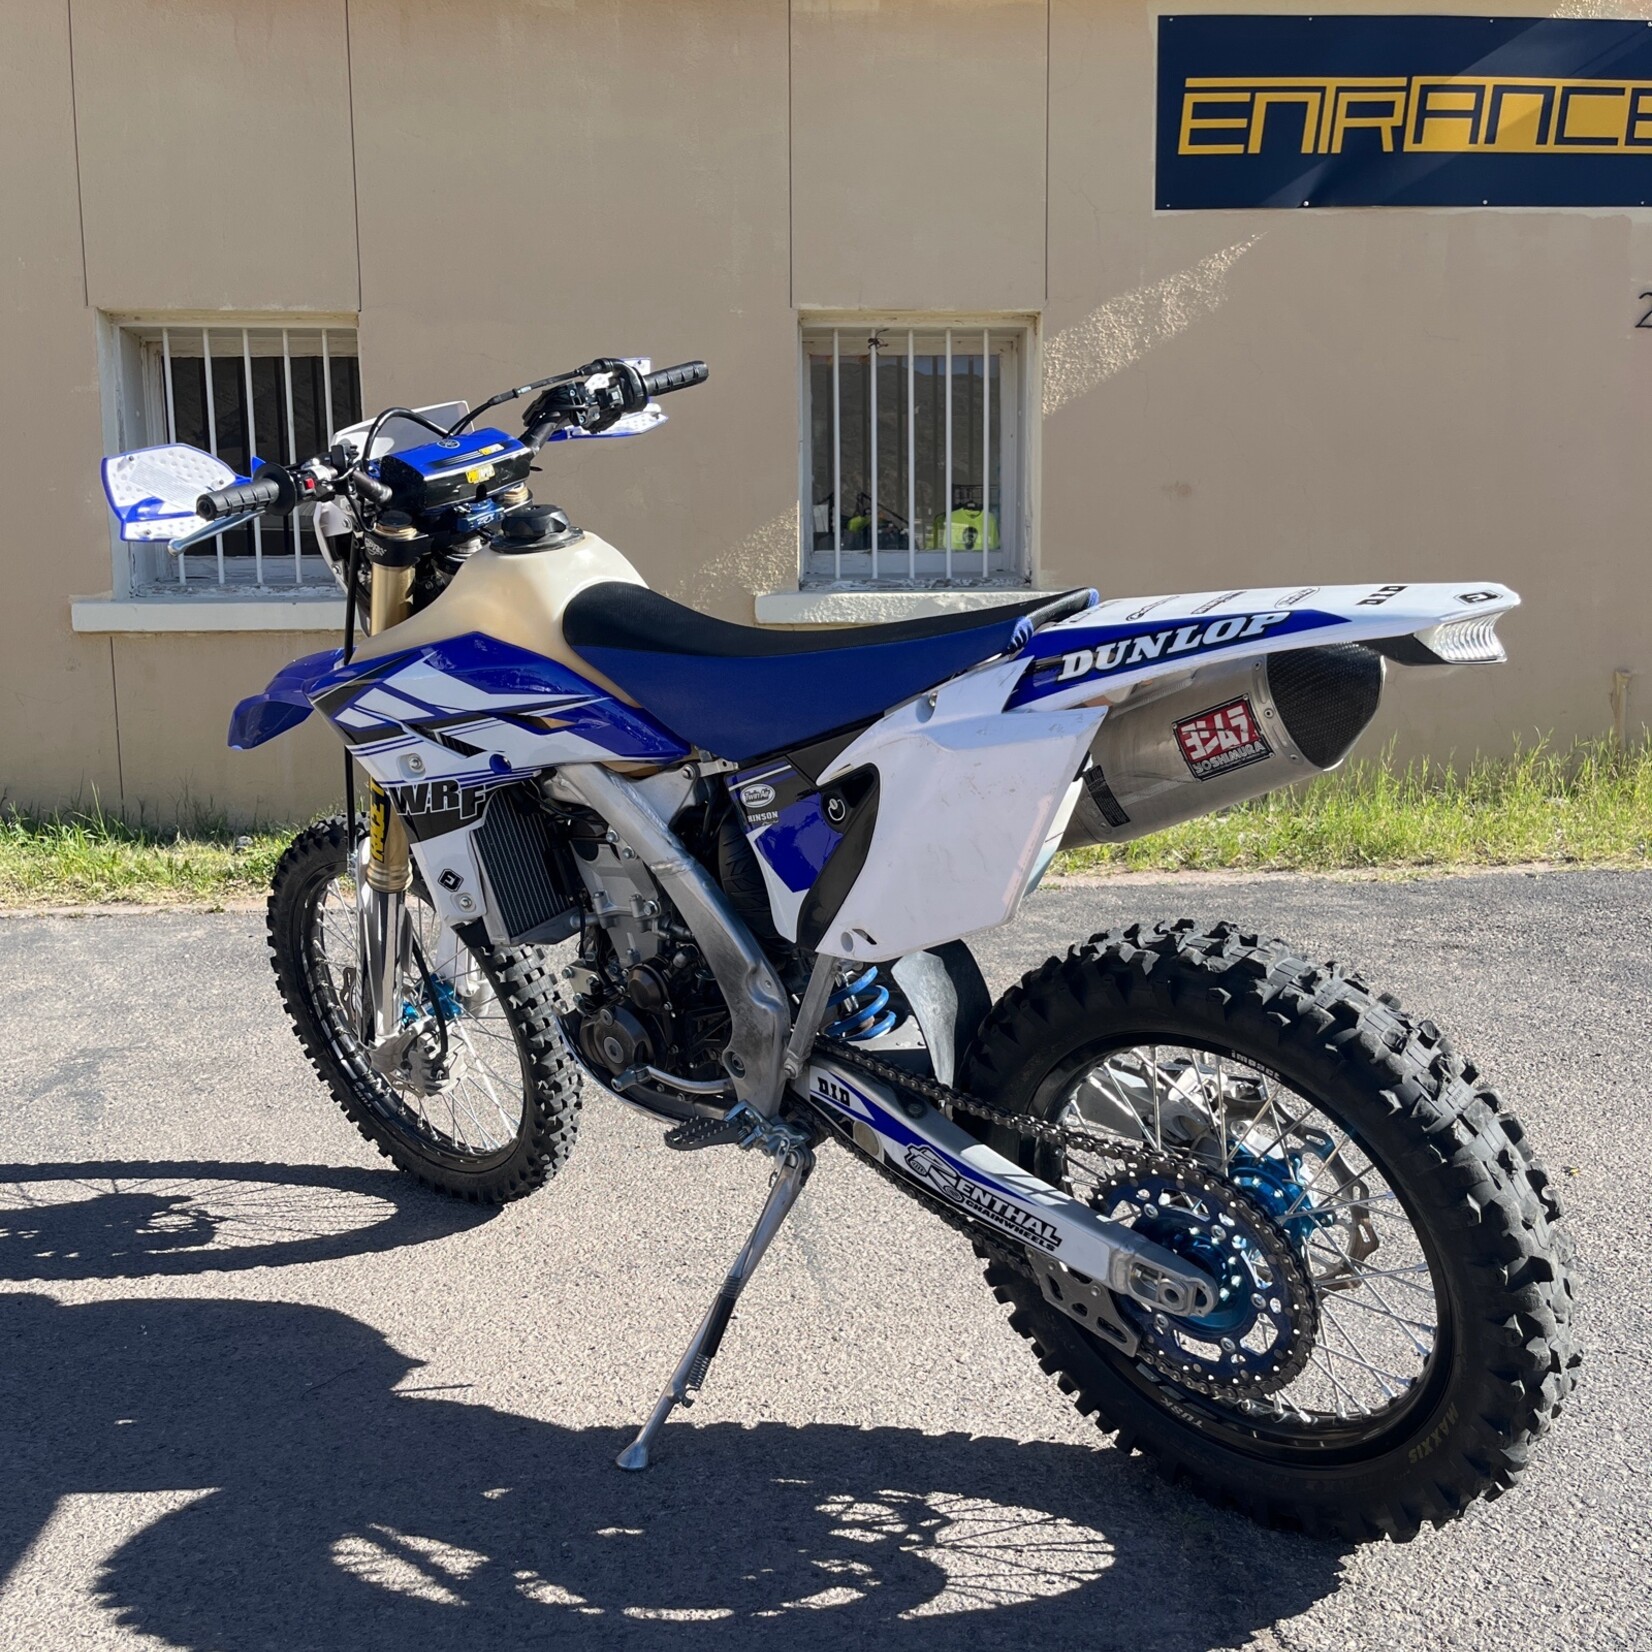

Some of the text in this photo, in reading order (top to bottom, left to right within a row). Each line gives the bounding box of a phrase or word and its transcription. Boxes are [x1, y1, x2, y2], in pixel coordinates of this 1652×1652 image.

[1057, 611, 1290, 681] DUNLOP
[1192, 740, 1266, 774] YOSHIMURA
[388, 779, 486, 820] WRF
[370, 803, 385, 863] RACE
[904, 1144, 1062, 1247] RENTHAL
[965, 1199, 1055, 1251] CHAINWHEELS
[1160, 1395, 1203, 1429] TUSK
[1408, 1401, 1459, 1463] MAXXIS
